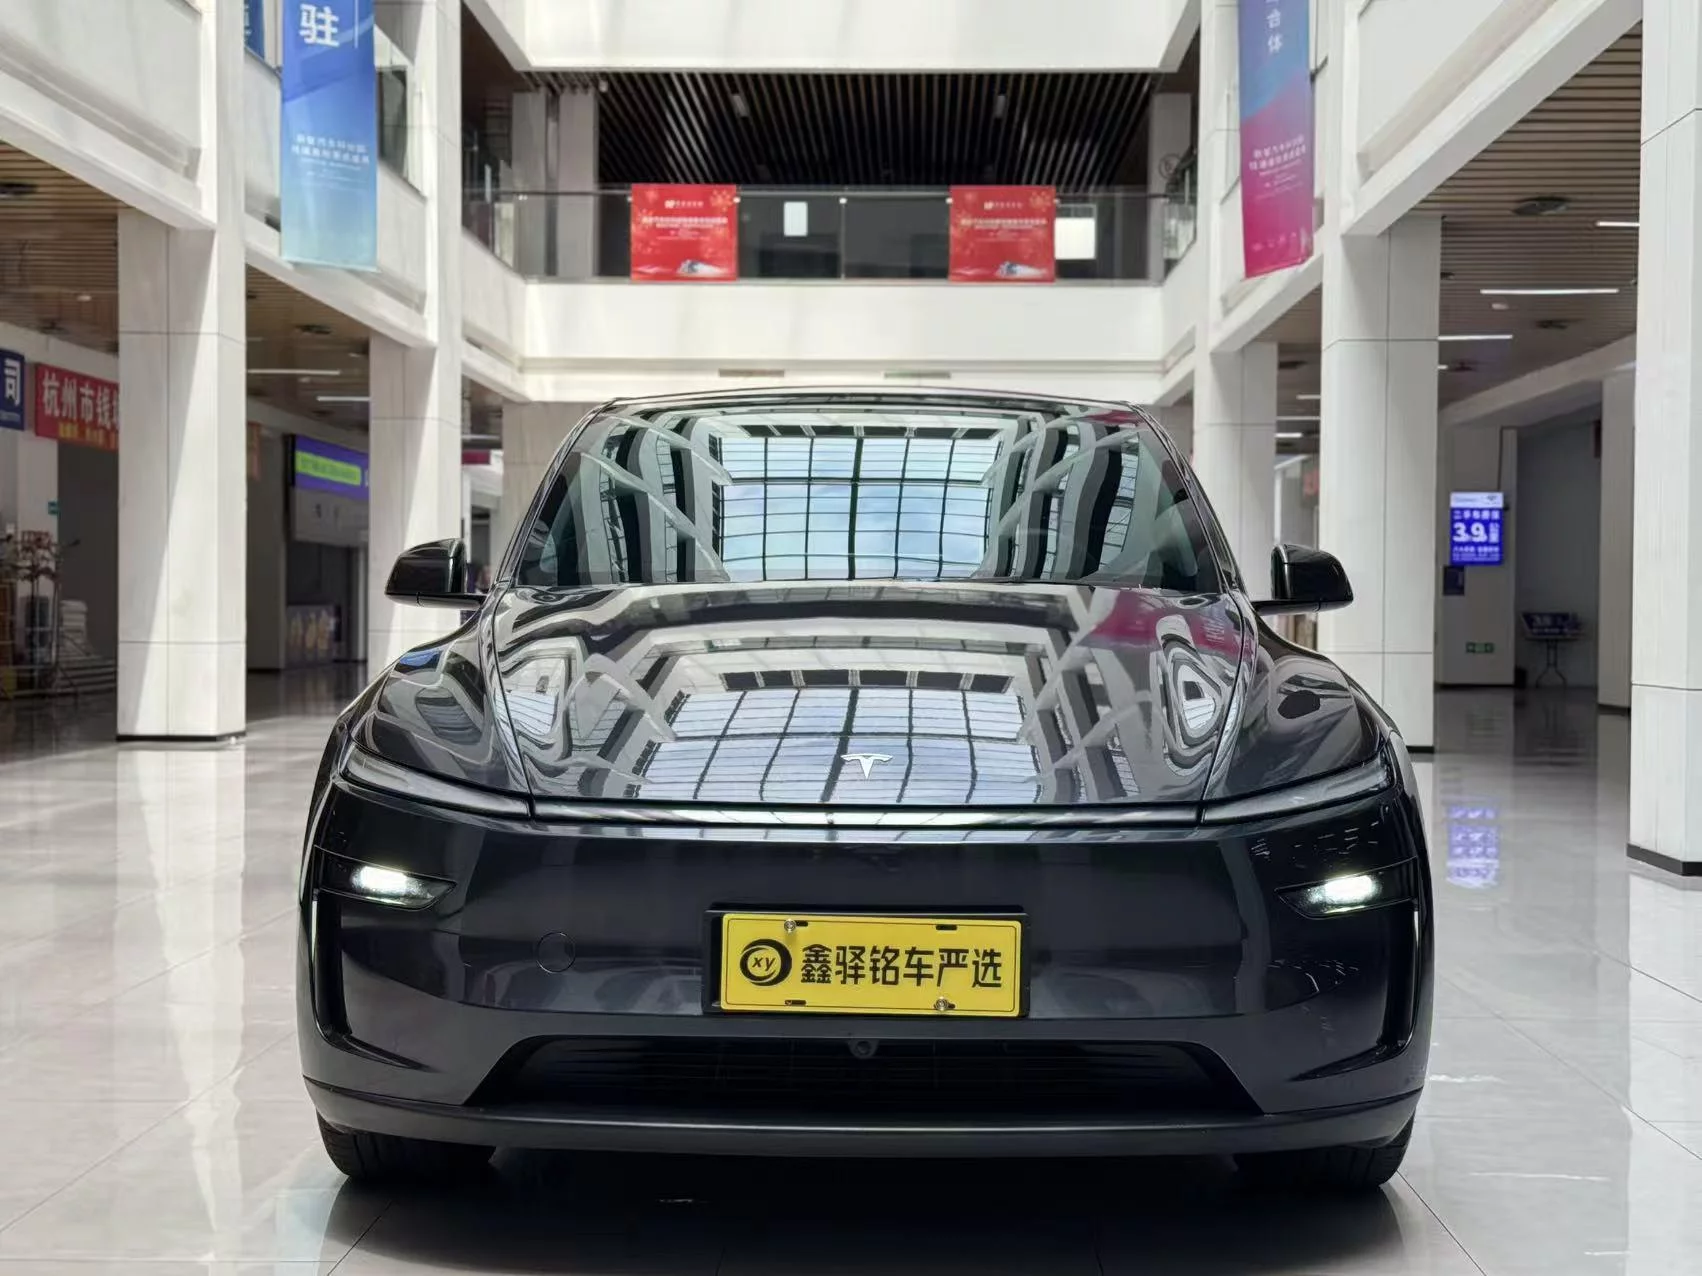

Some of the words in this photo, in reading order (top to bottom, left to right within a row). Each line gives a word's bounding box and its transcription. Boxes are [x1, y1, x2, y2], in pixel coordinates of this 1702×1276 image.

[299, 3, 340, 47] 驻
[3, 358, 21, 407] 司
[801, 943, 1002, 988] 鑫驿铭车严选
